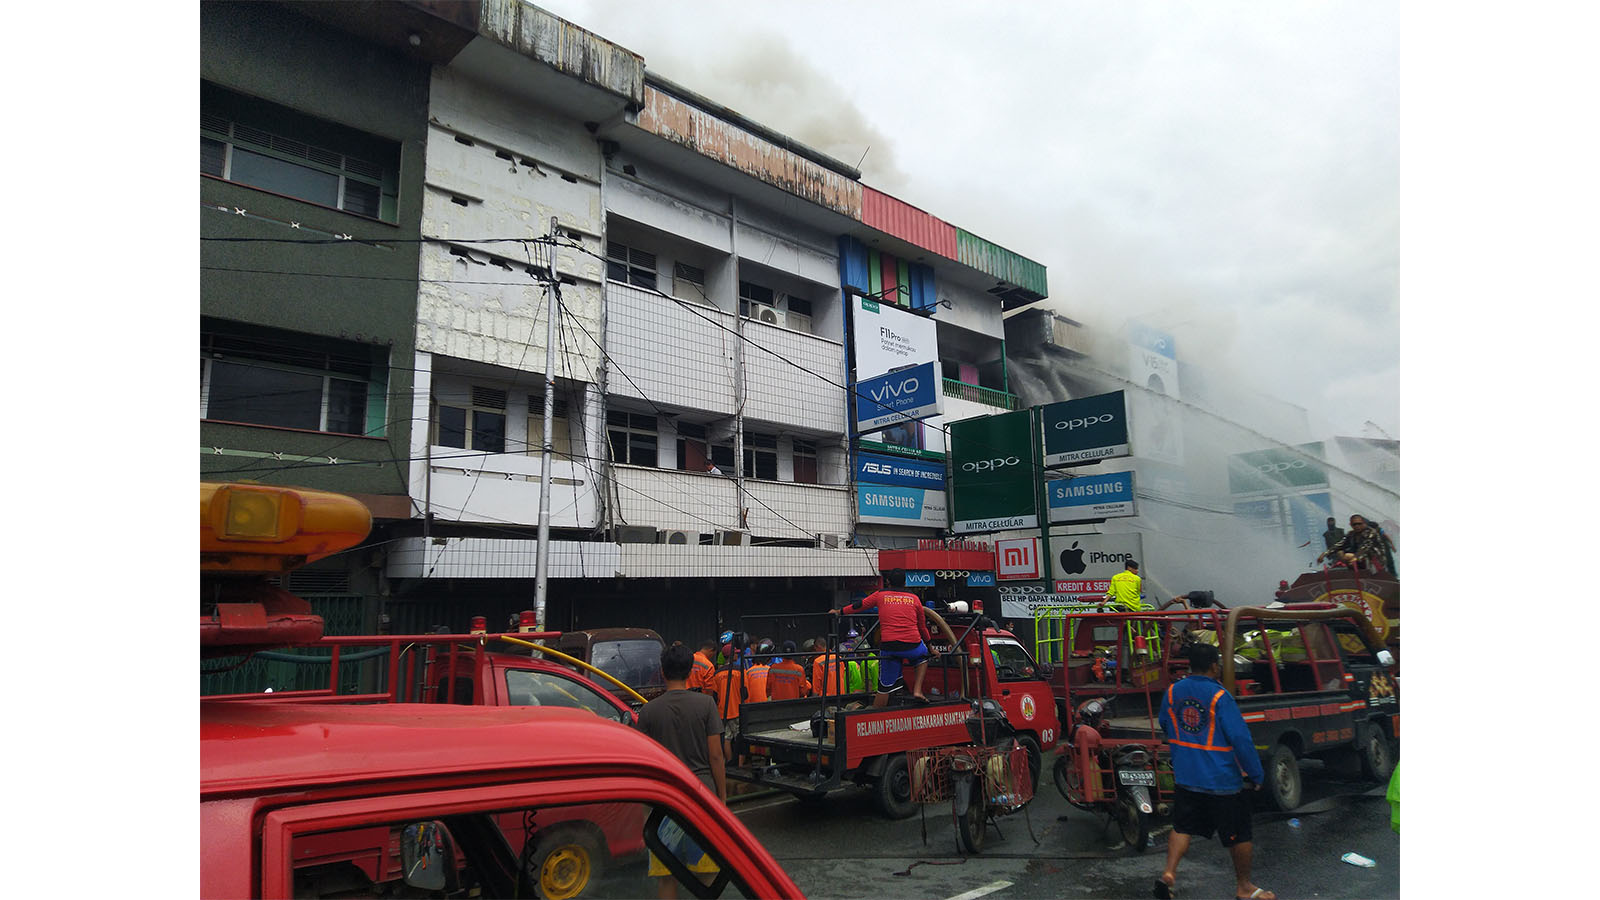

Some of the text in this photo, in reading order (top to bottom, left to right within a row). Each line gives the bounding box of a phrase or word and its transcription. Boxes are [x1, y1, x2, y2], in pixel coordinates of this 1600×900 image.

[870, 378, 918, 402] vivo
[896, 398, 914, 407] Phone
[874, 416, 890, 425] MITRA
[1059, 448, 1114, 462] MITRA CELLULAR
[862, 462, 892, 475] ASUS
[898, 468, 914, 478] SEARCH
[920, 472, 942, 480] INCREDIBLE
[1056, 482, 1123, 498] SAMSUNG
[865, 493, 915, 508] SAMSUNG
[966, 518, 1024, 530] MITRA CELLULAR
[918, 539, 989, 552] MITRA CELLULAR
[1090, 552, 1132, 563] iPhone
[908, 572, 930, 582] vivo
[971, 573, 991, 583] vivo
[1057, 582, 1084, 591] KREDIT
[1086, 582, 1092, 590] &
[857, 720, 885, 736] RELAWAN
[886, 717, 912, 733] PEMADAM
[913, 714, 944, 730] KEBAKARAN
[944, 710, 965, 726] SIANTAN
[1042, 728, 1054, 743] 03
